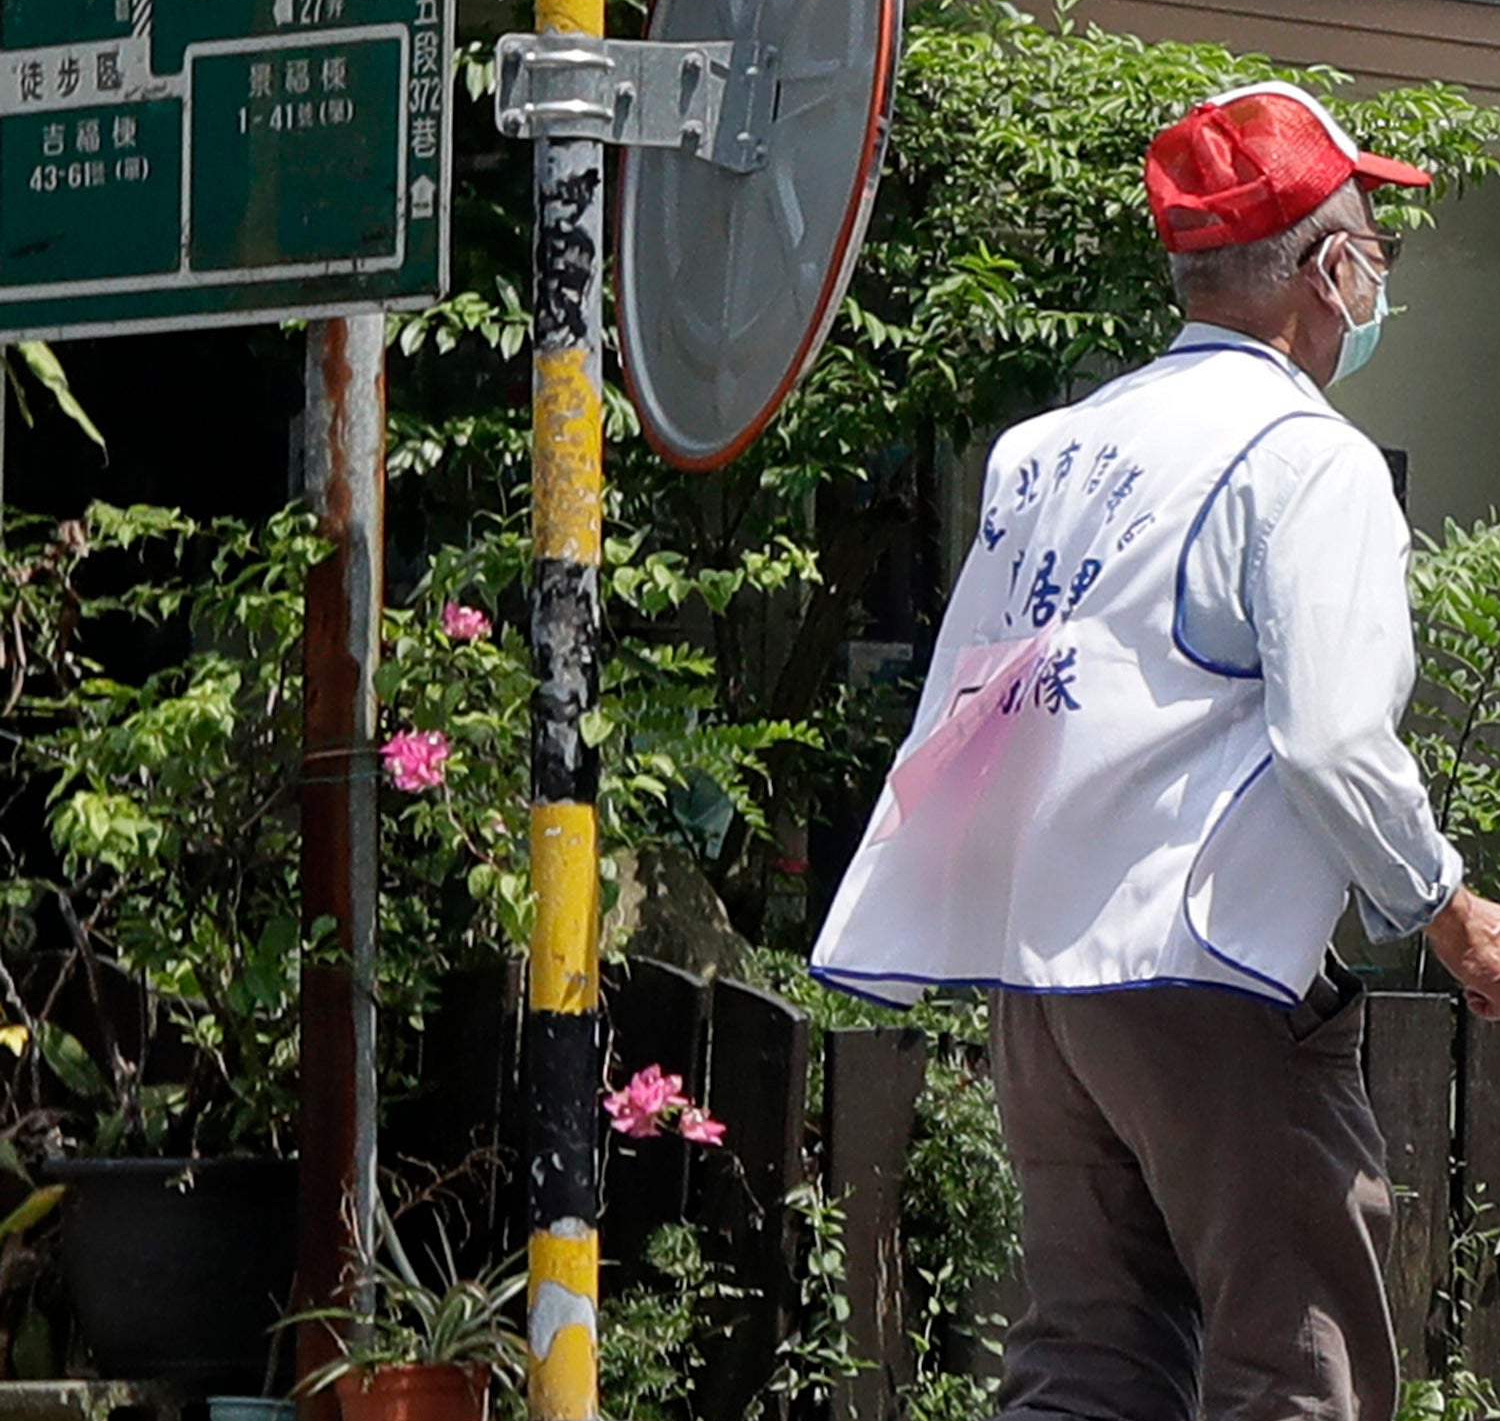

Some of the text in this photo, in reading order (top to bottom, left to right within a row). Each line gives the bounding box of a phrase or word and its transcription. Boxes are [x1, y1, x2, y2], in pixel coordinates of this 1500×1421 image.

[19, 51, 123, 102] 徒步區
[42, 115, 137, 156] 吉福棟
